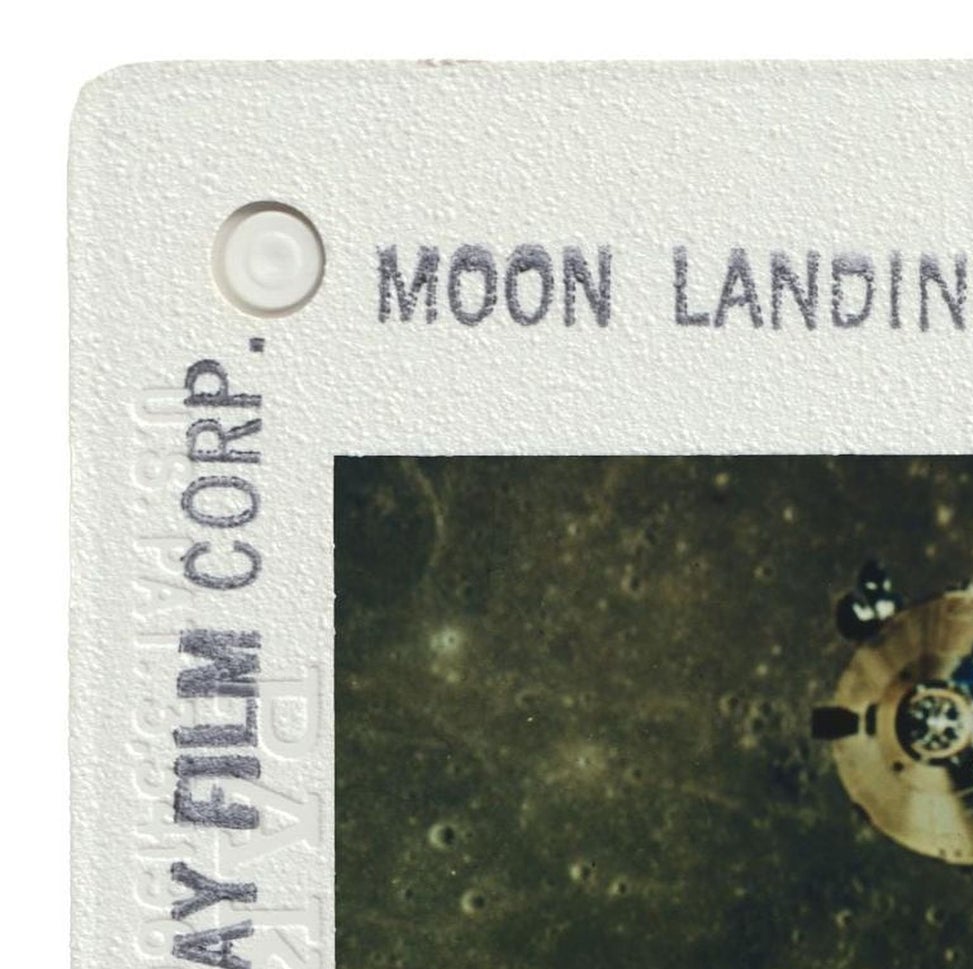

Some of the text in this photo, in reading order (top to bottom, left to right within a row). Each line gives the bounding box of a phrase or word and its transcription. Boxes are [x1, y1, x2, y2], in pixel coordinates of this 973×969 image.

[375, 242, 614, 330] MOON
[177, 335, 267, 593] CORP.
[169, 627, 264, 832] FILM
